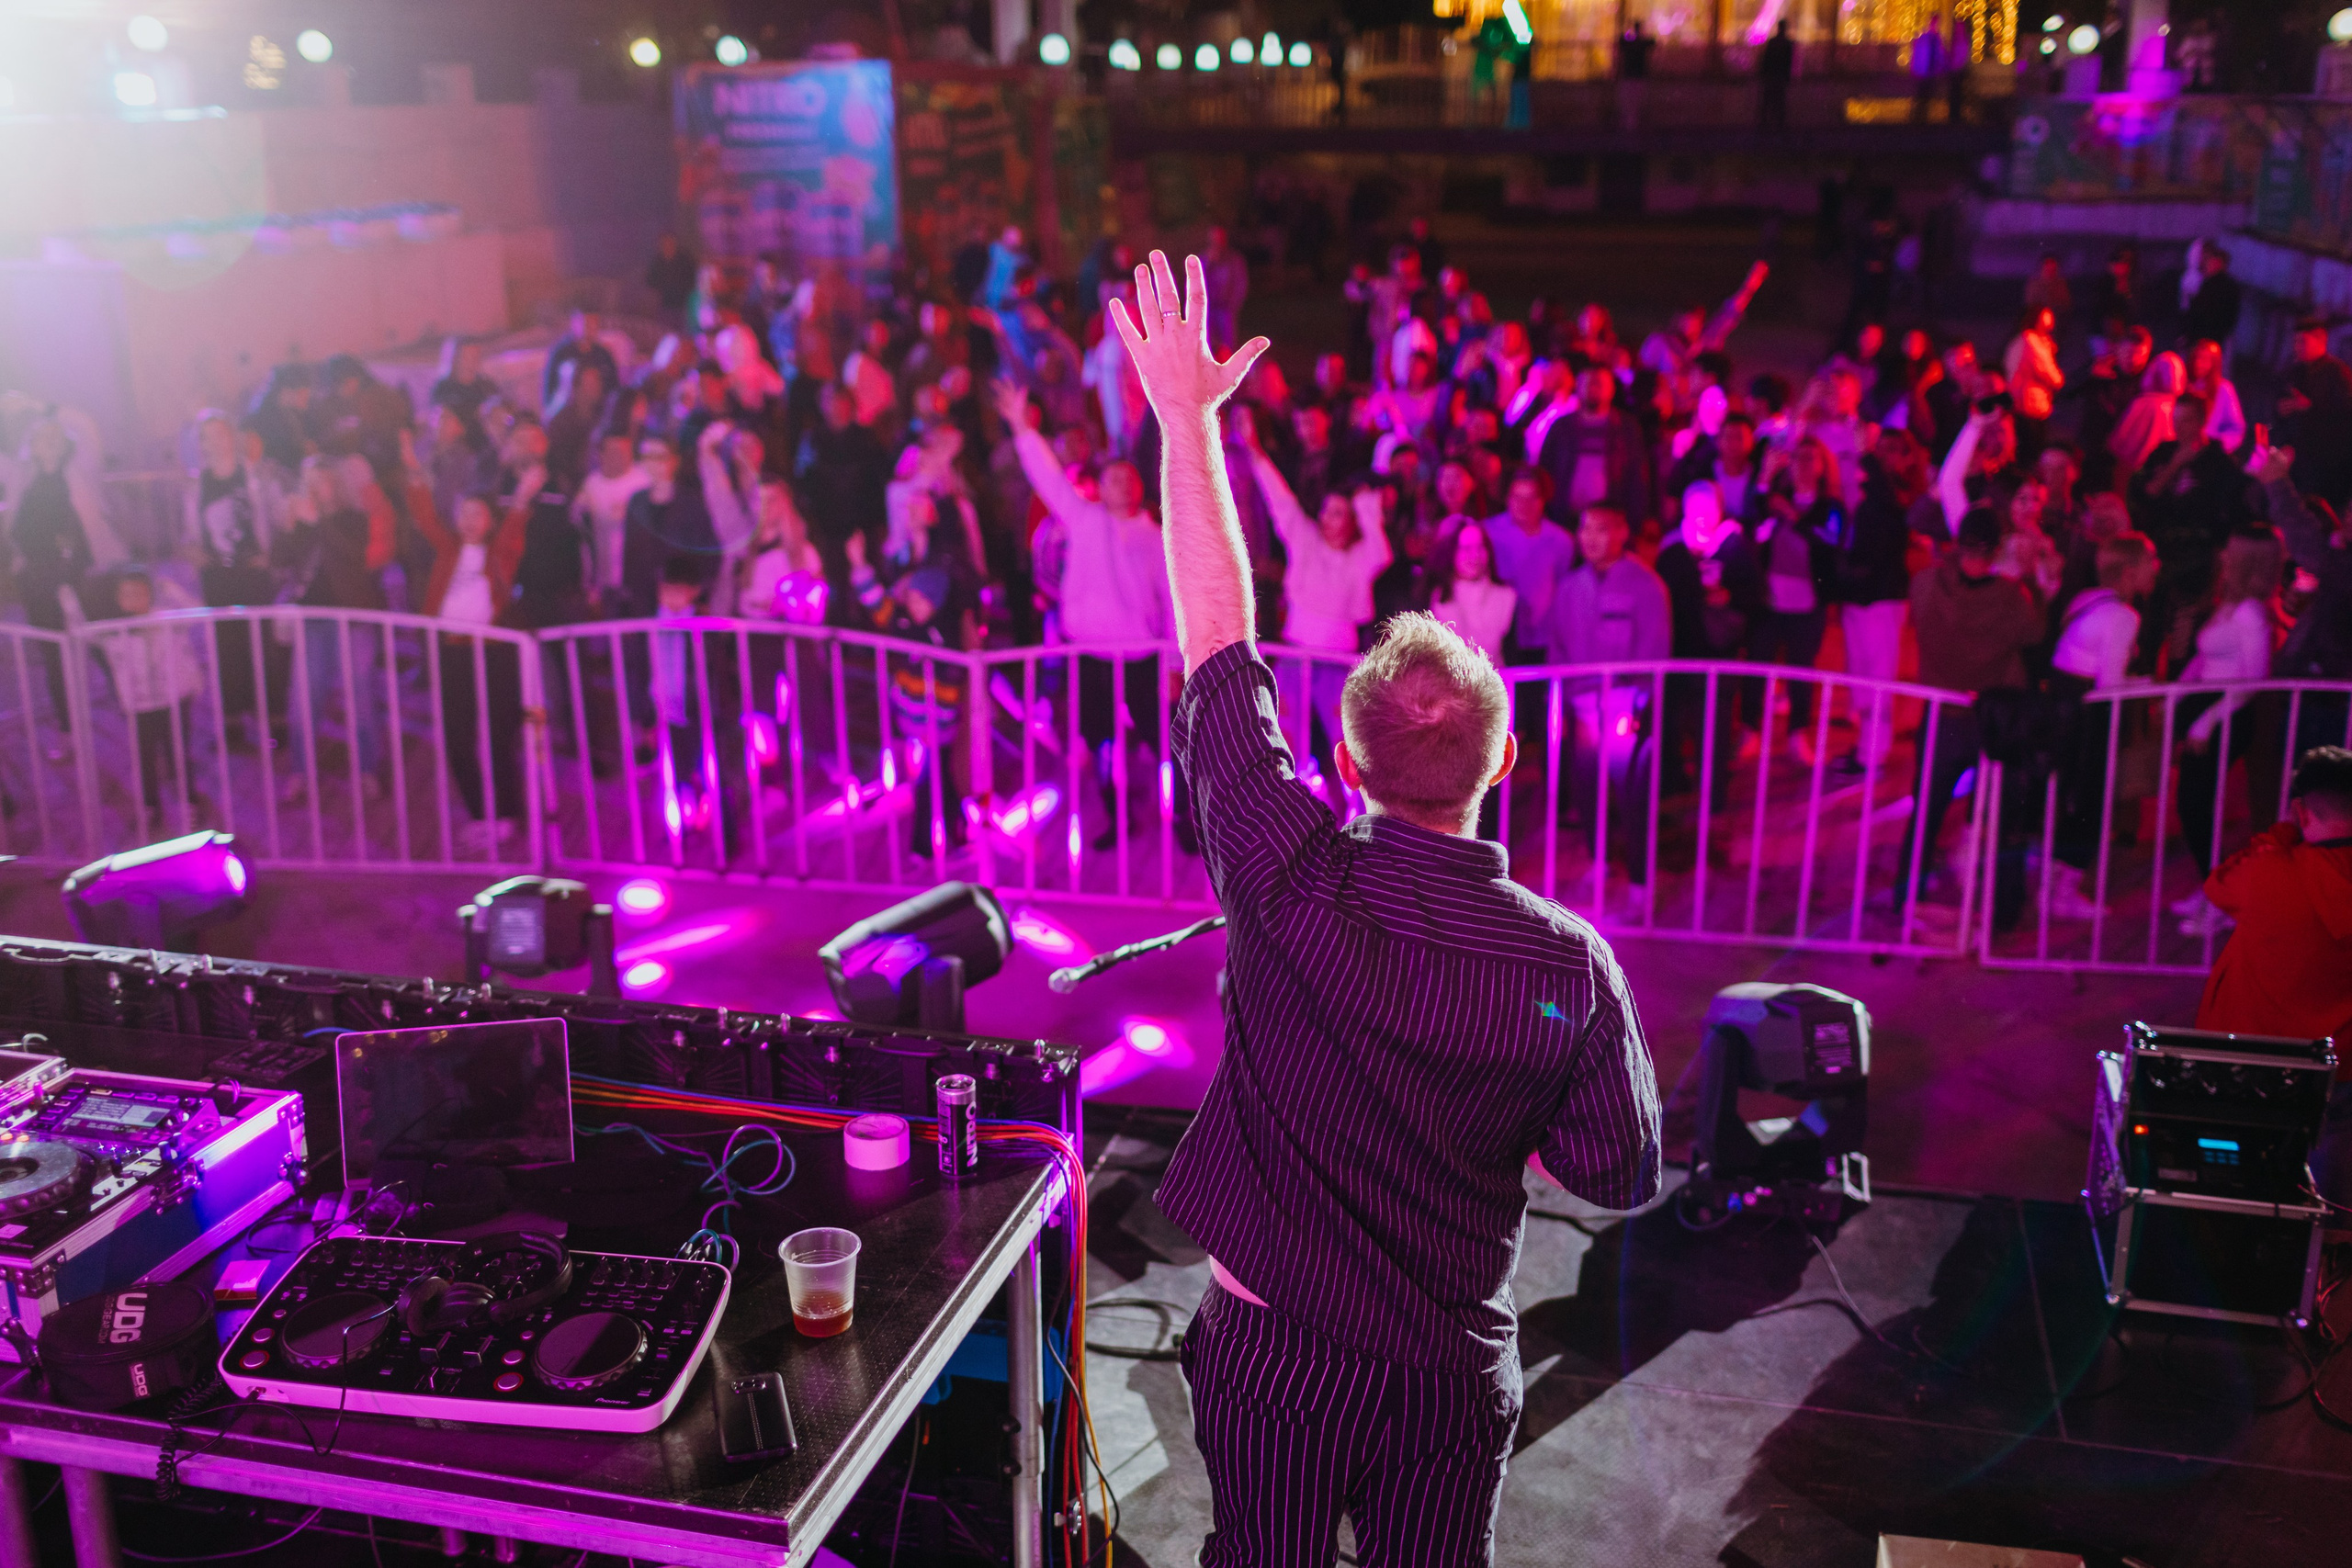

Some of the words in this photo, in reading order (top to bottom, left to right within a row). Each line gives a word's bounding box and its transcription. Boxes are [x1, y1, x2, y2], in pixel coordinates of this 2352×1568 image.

[965, 1100, 978, 1168] NITRO
[109, 1292, 149, 1344] UDG
[133, 1363, 149, 1397] UDG
[594, 1396, 631, 1405] Pioneer
